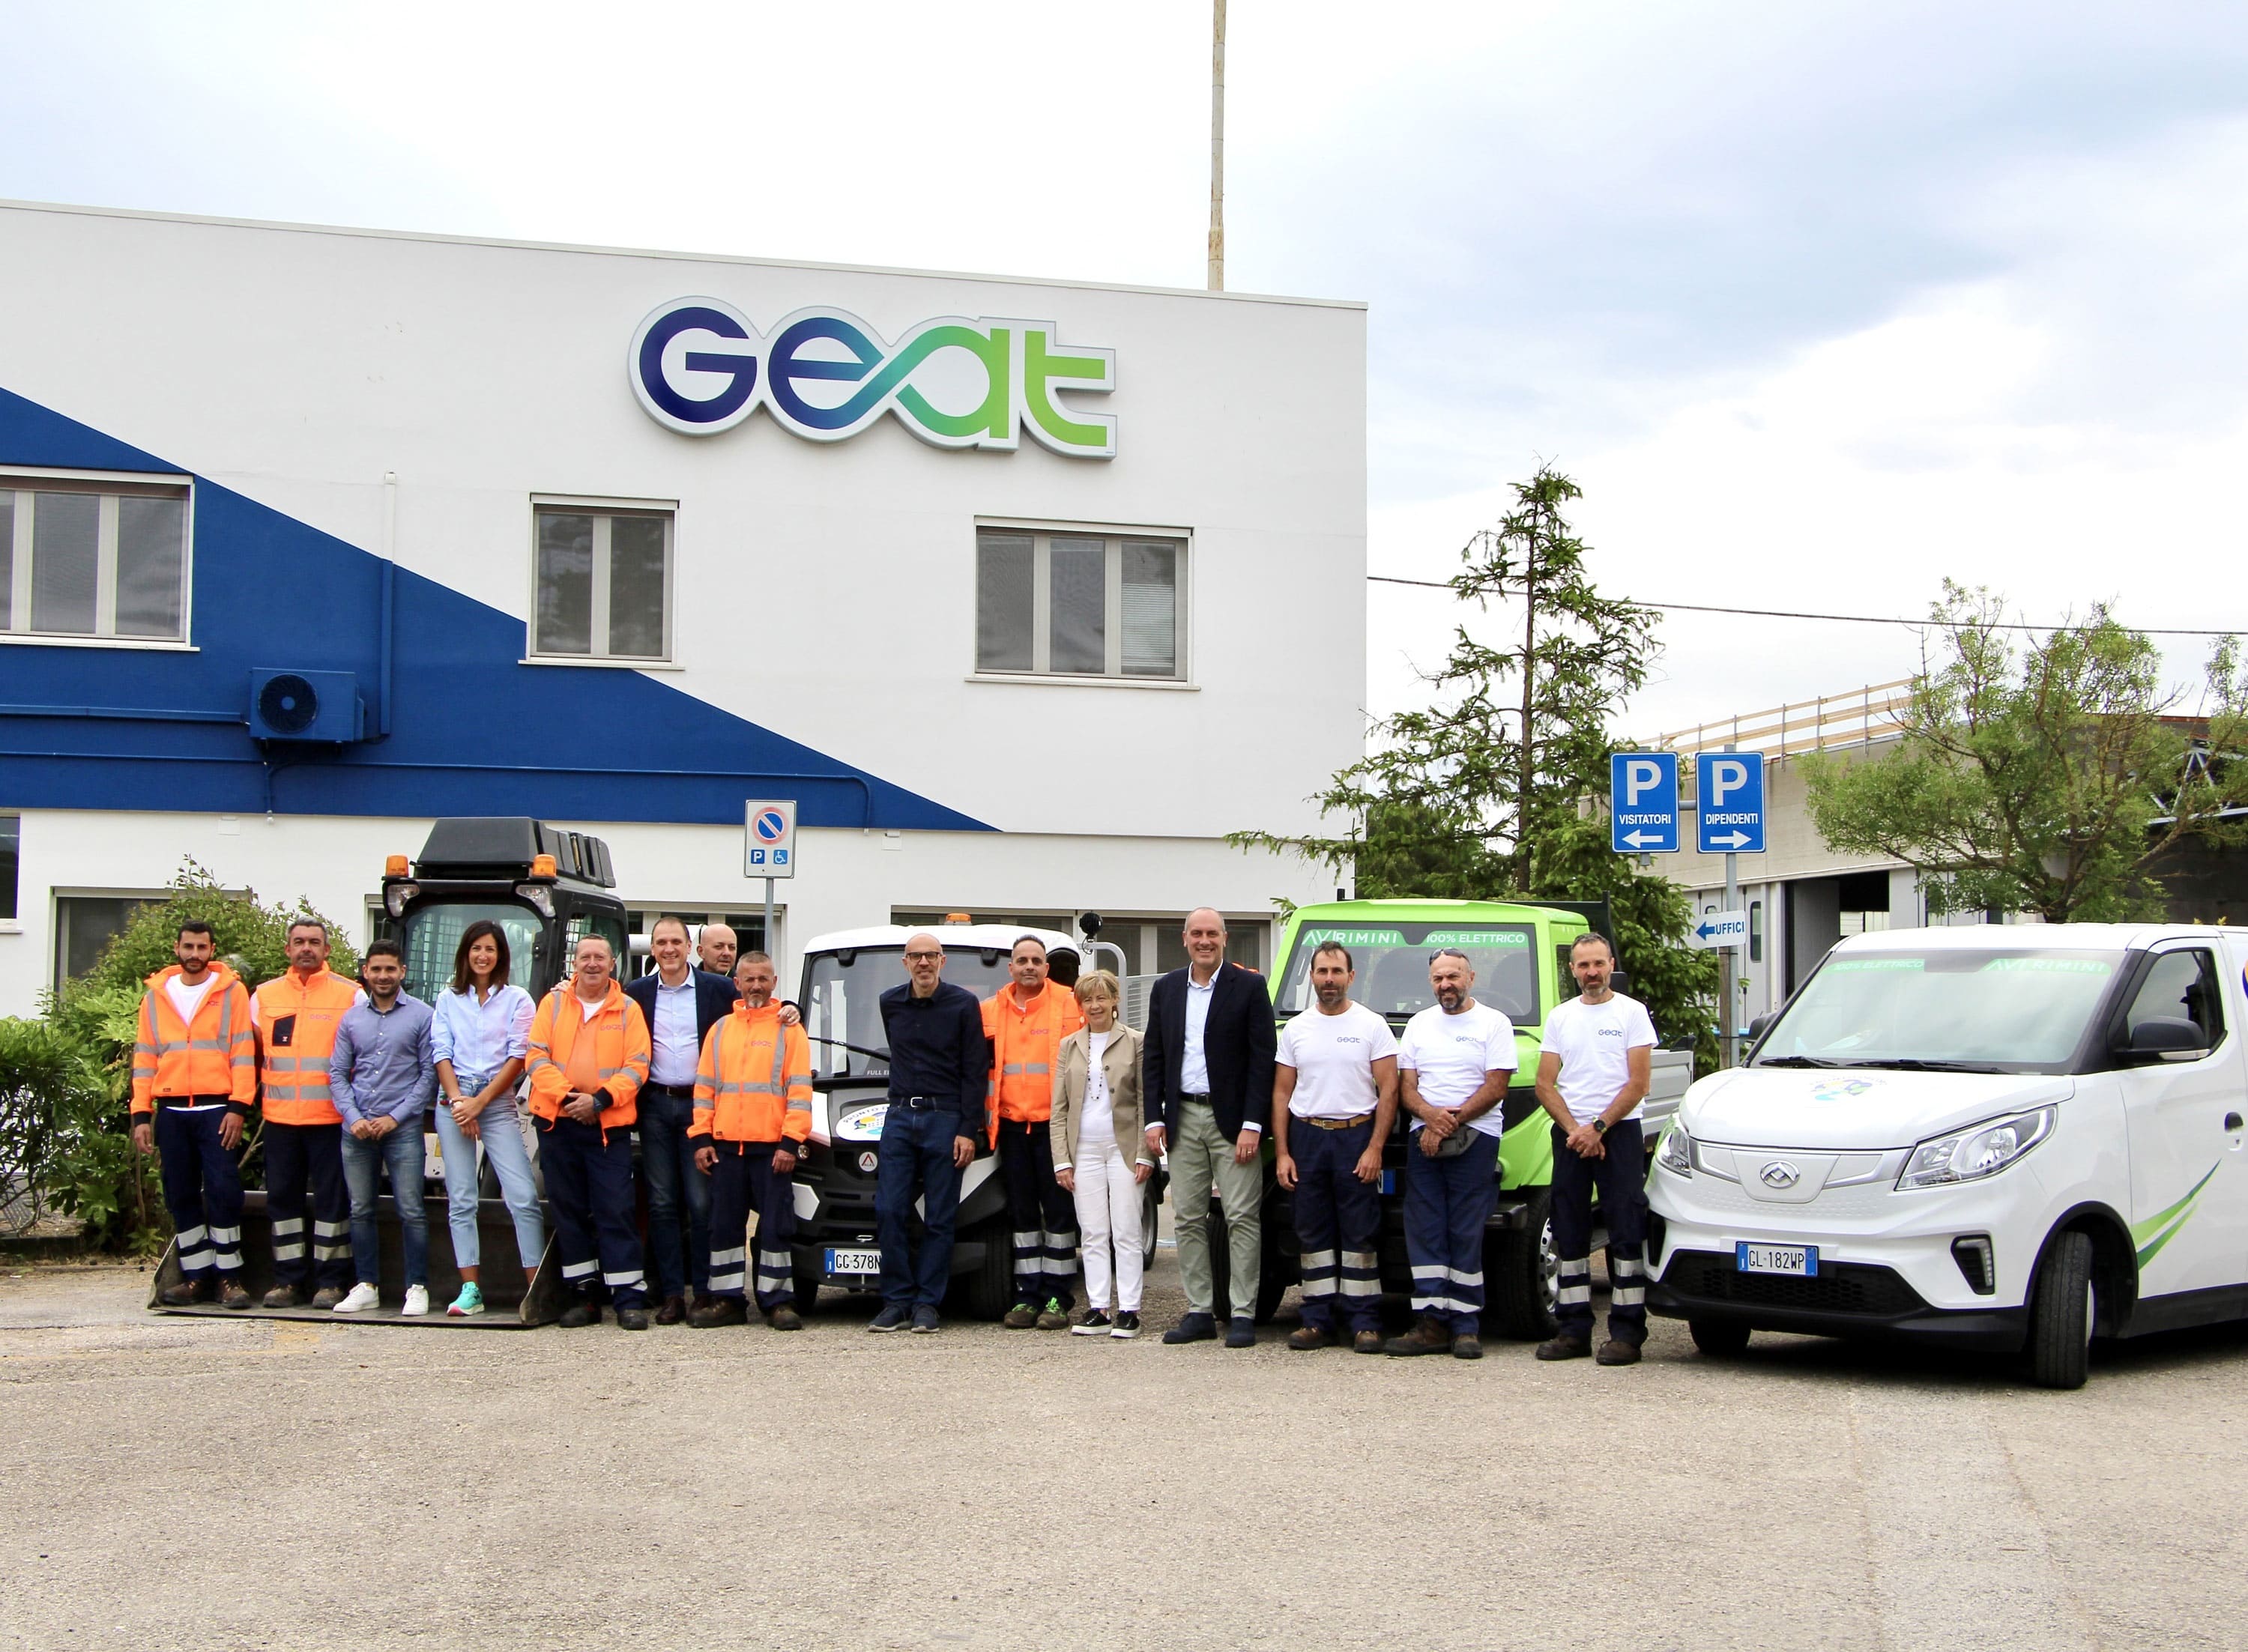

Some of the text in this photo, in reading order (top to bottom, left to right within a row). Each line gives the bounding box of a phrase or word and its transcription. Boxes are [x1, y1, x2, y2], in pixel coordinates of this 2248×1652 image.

[1626, 760, 1662, 806] P
[1711, 760, 1748, 807] P
[1619, 814, 1672, 825] VISITATORI
[1705, 813, 1759, 825] DIPENDENTI
[753, 851, 763, 862] P
[1714, 921, 1745, 936] UFFICI
[1335, 932, 1398, 943] RIMINI
[1426, 934, 1526, 943] 100% ELETTRICO
